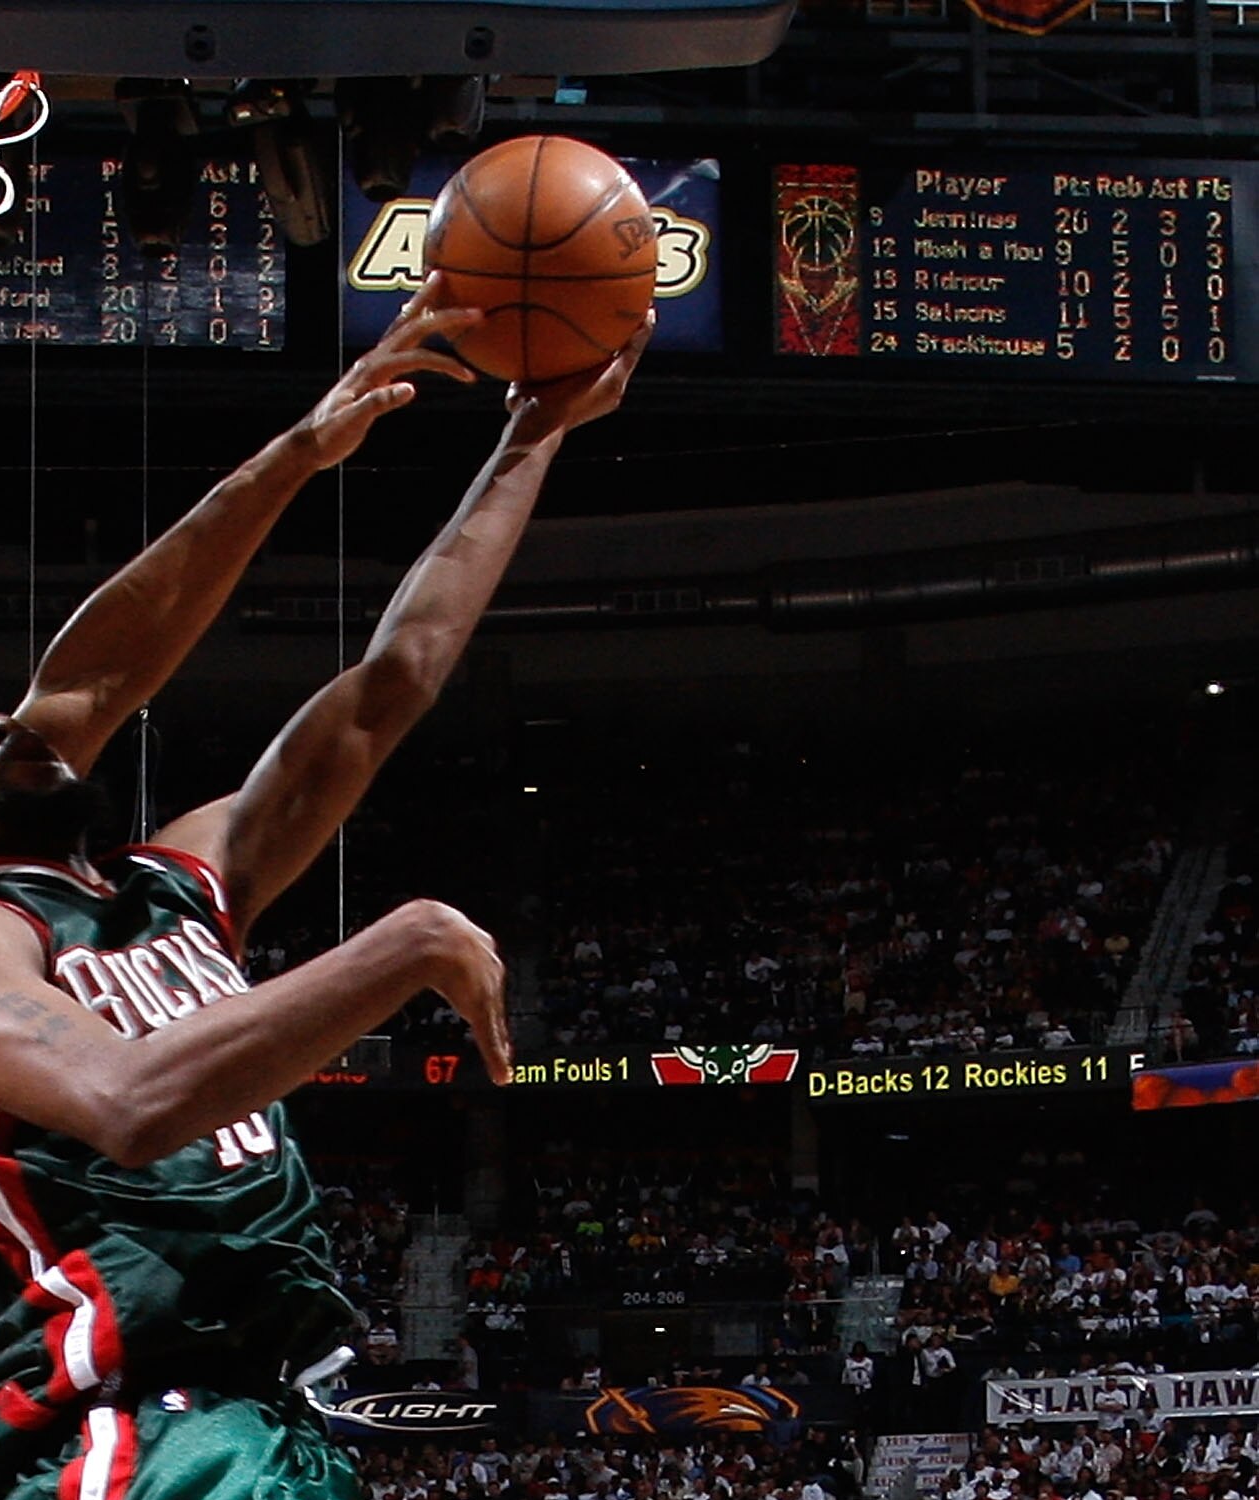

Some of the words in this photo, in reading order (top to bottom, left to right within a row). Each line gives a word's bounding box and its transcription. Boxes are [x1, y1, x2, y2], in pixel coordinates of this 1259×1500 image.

[916, 168, 1009, 200] Player
[1095, 174, 1143, 199] Reb
[1148, 177, 1190, 200] Ast
[257, 222, 275, 250] 2
[1111, 208, 1130, 235] 2
[1159, 209, 1178, 236] 3
[1206, 210, 1223, 238] 2
[209, 254, 228, 280] 0
[1055, 238, 1073, 265] 9
[1112, 239, 1131, 267] 5
[1159, 239, 1179, 268] 0
[1206, 243, 1225, 270] 3
[101, 285, 136, 313] 20
[213, 286, 225, 313] 1
[1056, 269, 1092, 297] 10
[1112, 270, 1131, 299] 2
[1162, 273, 1176, 299] 1
[1206, 273, 1226, 300] 0
[101, 316, 137, 344] 20
[209, 316, 228, 344] 0
[257, 316, 272, 345] 1
[872, 299, 899, 322] 15
[1057, 301, 1090, 329] 11
[1112, 301, 1132, 330] 5
[1161, 303, 1180, 331] 5
[1208, 304, 1223, 333] 1
[1056, 332, 1075, 360] 5
[1113, 333, 1132, 362] 2
[1161, 335, 1181, 363] 0
[1208, 335, 1227, 363] 0
[54, 917, 249, 1042] BUCKS
[425, 1054, 461, 1084] 67
[554, 1058, 613, 1083] Fouls
[618, 1056, 630, 1081] 1
[809, 1070, 914, 1097] D-Backs
[921, 1066, 950, 1091] 12
[965, 1061, 1067, 1088] Rockies
[1081, 1056, 1108, 1082] 11
[365, 1403, 497, 1419] LIGHT
